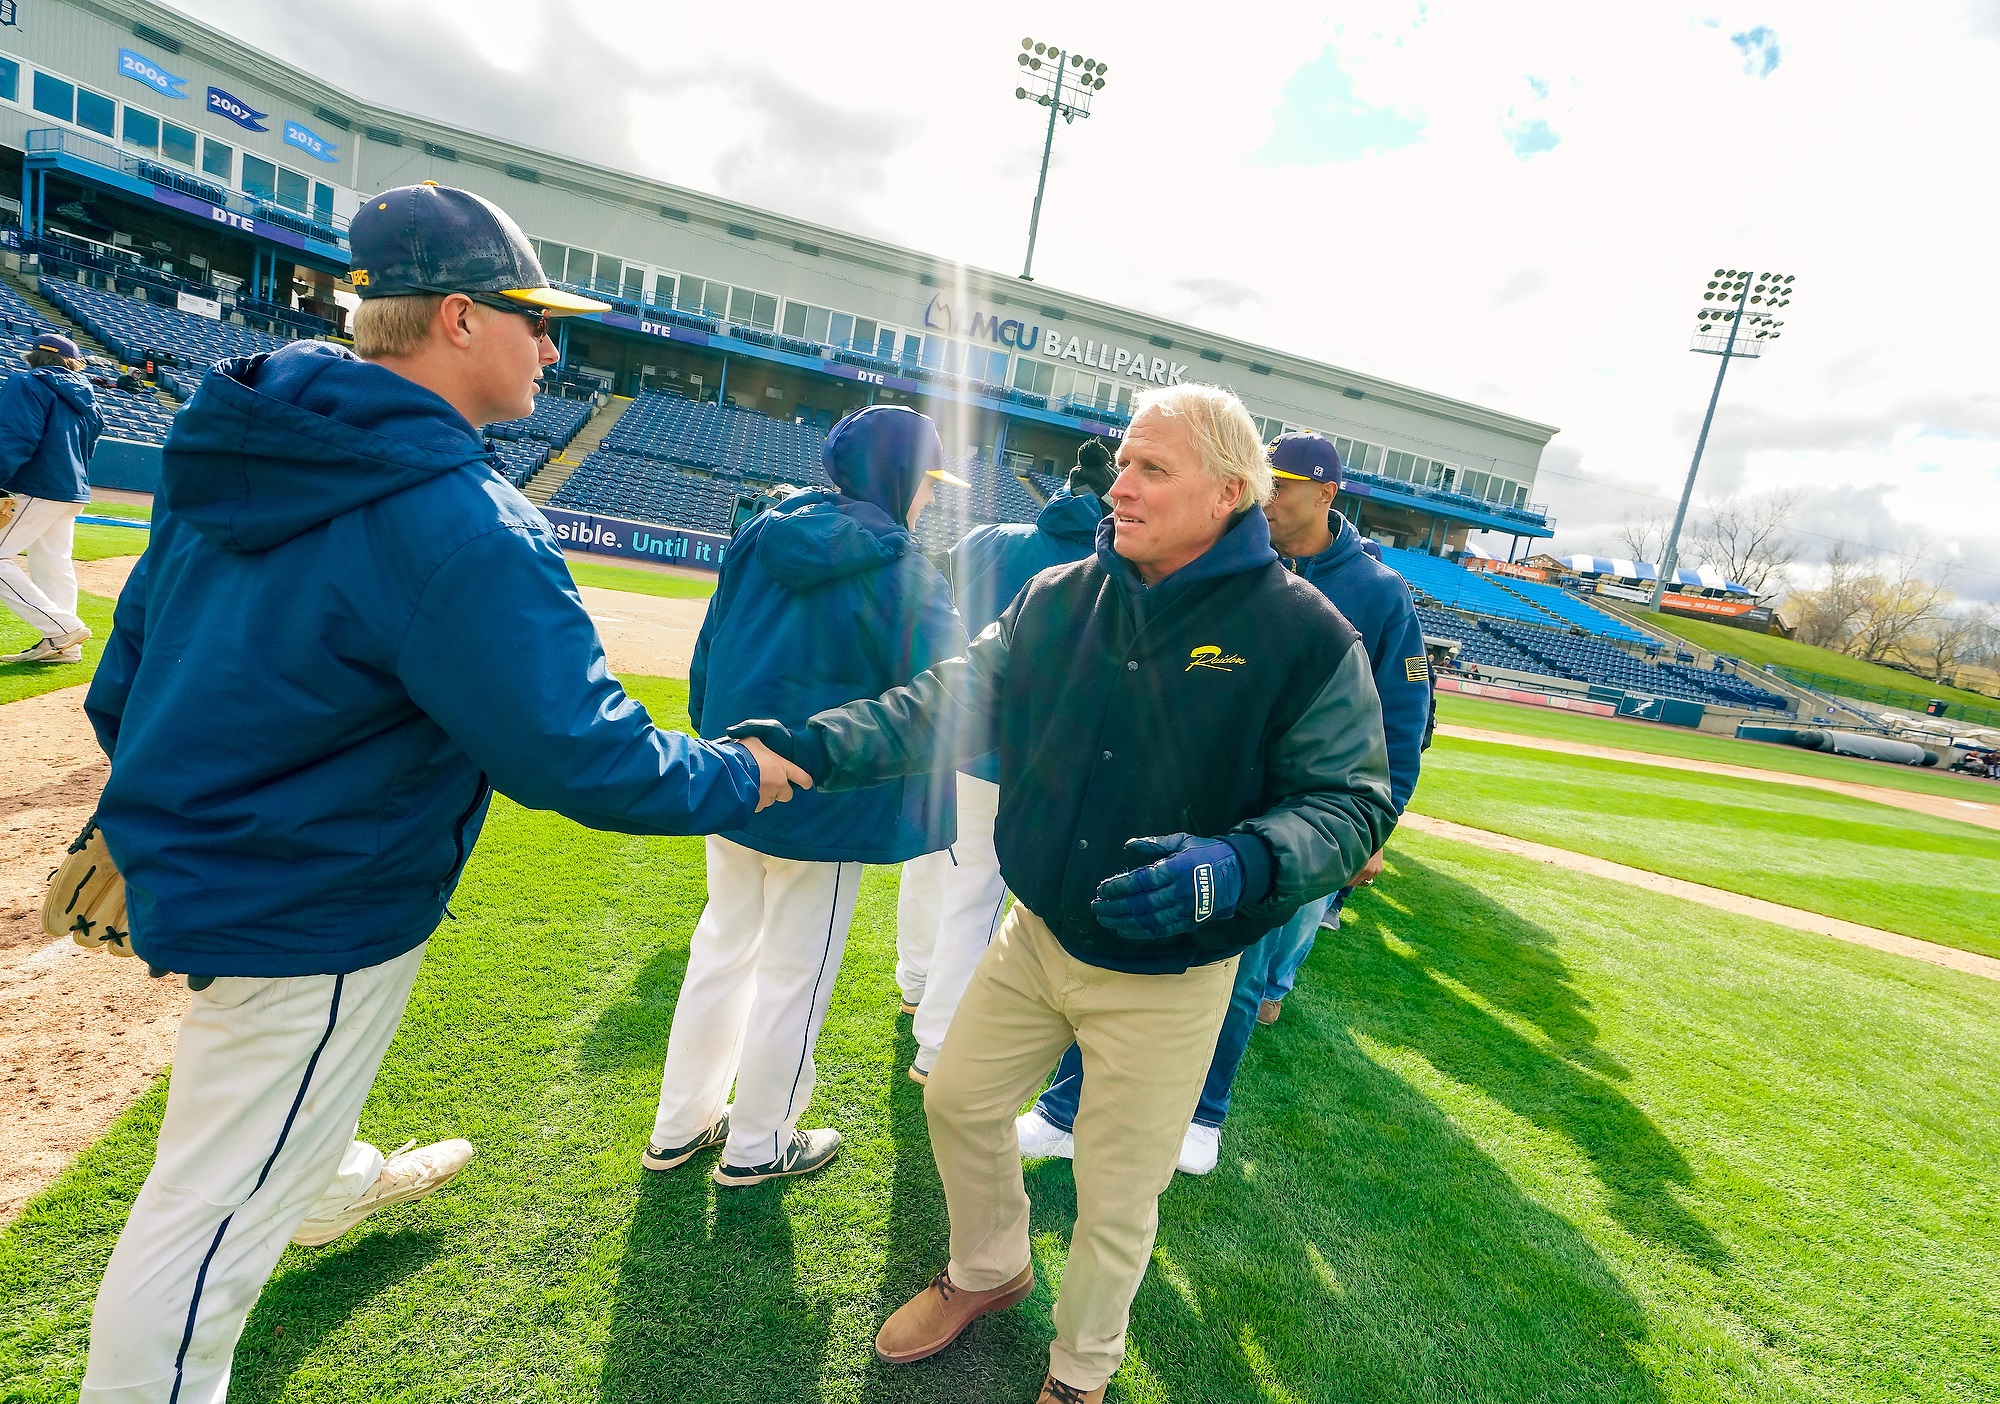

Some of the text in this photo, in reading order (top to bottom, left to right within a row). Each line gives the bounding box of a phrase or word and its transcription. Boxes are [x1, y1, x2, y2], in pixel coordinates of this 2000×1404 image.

[123, 56, 168, 87] 2006
[210, 94, 252, 121] 2007
[288, 127, 322, 152] 2015
[212, 206, 254, 233] DTE
[641, 321, 671, 338] DTE
[952, 307, 1188, 386] LMCU BALLPARK
[857, 370, 885, 385] DTE
[1108, 427, 1125, 439] DT
[632, 531, 689, 558] Until
[695, 541, 712, 562] it
[717, 544, 726, 564] i
[1502, 563, 1541, 579] Little Caesars
[1198, 868, 1211, 915] Franklin
